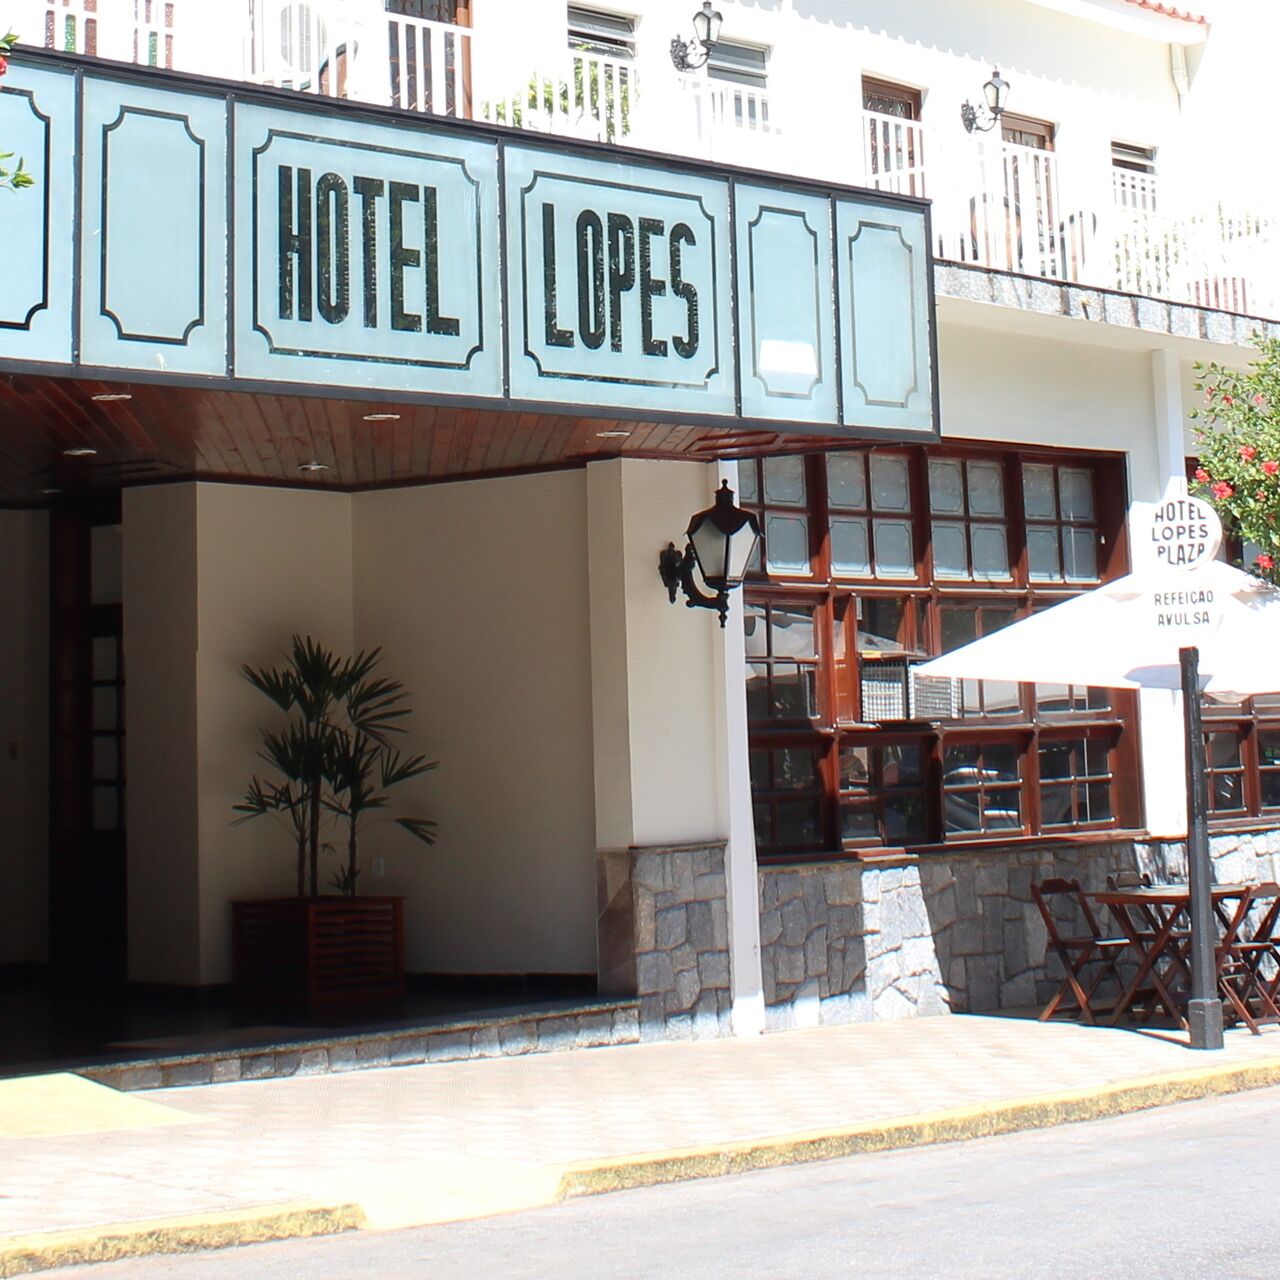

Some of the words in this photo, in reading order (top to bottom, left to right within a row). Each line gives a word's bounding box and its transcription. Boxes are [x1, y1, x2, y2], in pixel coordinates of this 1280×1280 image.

[278, 165, 461, 337] HOTEL
[542, 202, 700, 359] LOPES
[1154, 500, 1206, 522] HOTEL
[1151, 524, 1209, 542] LOPES
[1157, 543, 1205, 565] PLAZA
[1158, 611, 1210, 627] AVULSA
